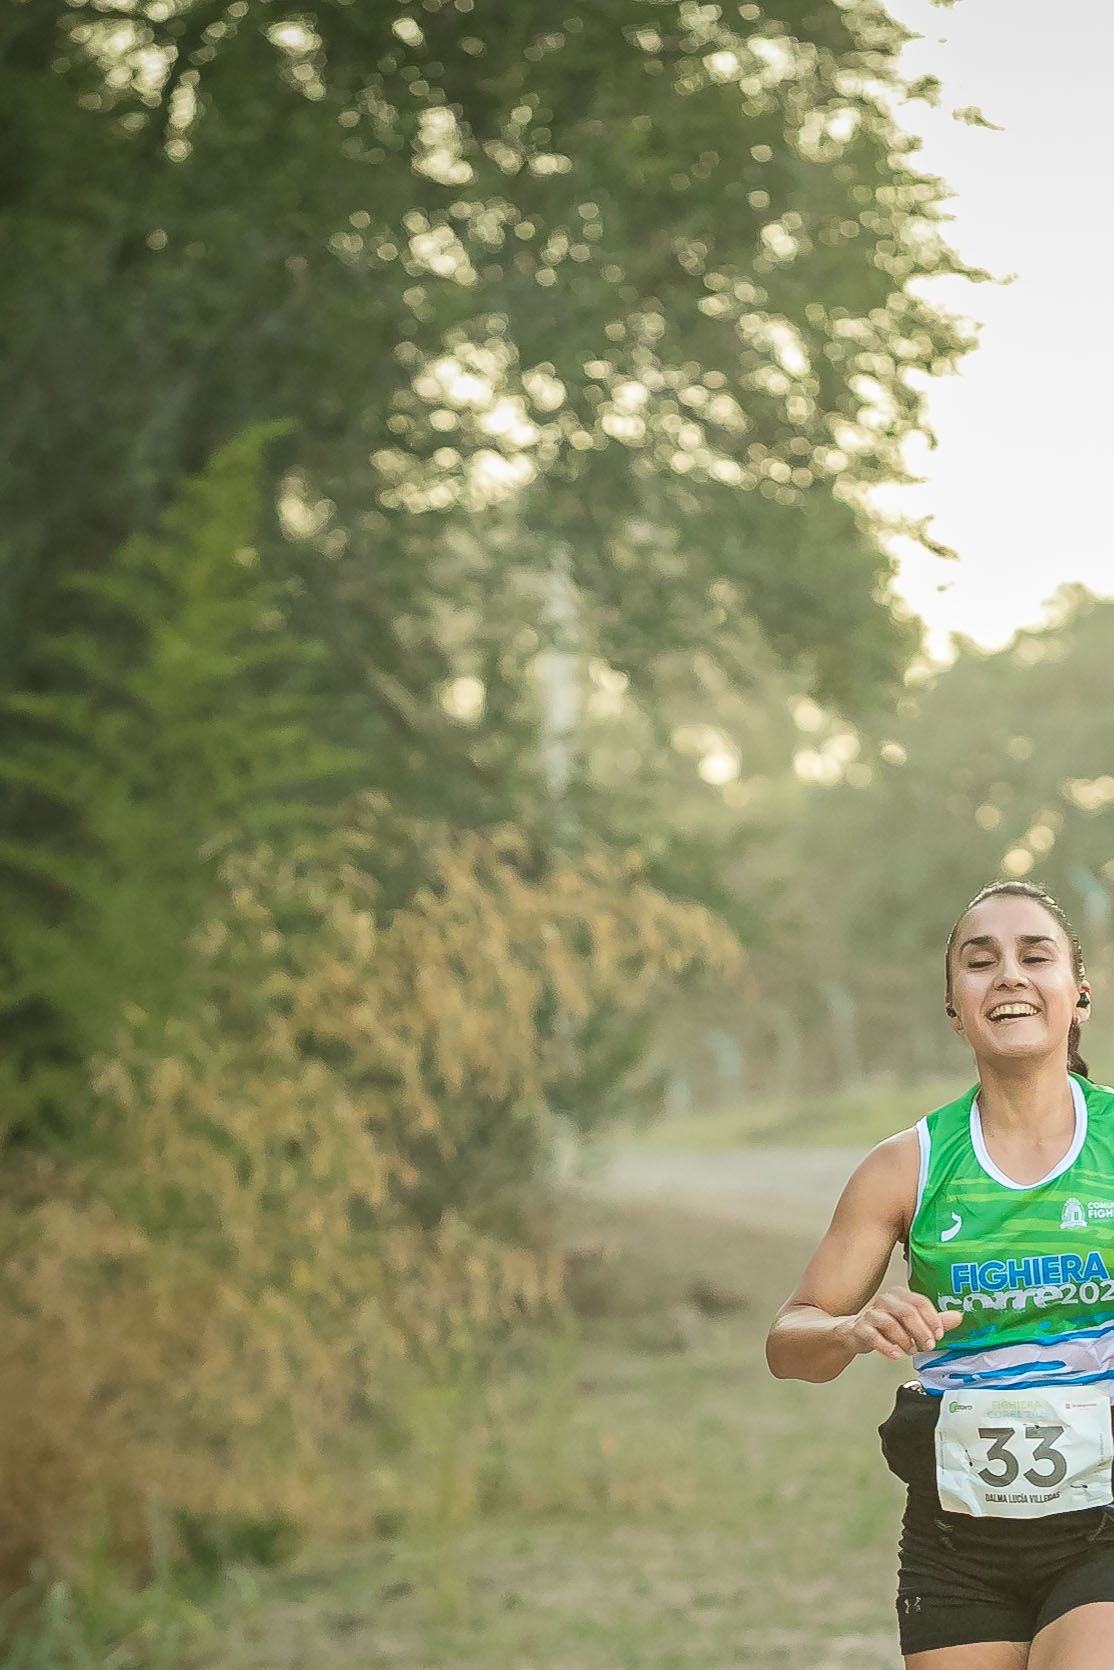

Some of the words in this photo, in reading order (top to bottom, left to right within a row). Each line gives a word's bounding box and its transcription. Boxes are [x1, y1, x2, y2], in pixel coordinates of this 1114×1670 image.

[951, 1251, 1110, 1294] FIGHIERA
[977, 1426, 1068, 1488] 33
[985, 1493, 1008, 1503] DALMA
[1008, 1492, 1029, 1503] LUCÍA
[1029, 1491, 1061, 1503] VILLEGAS
